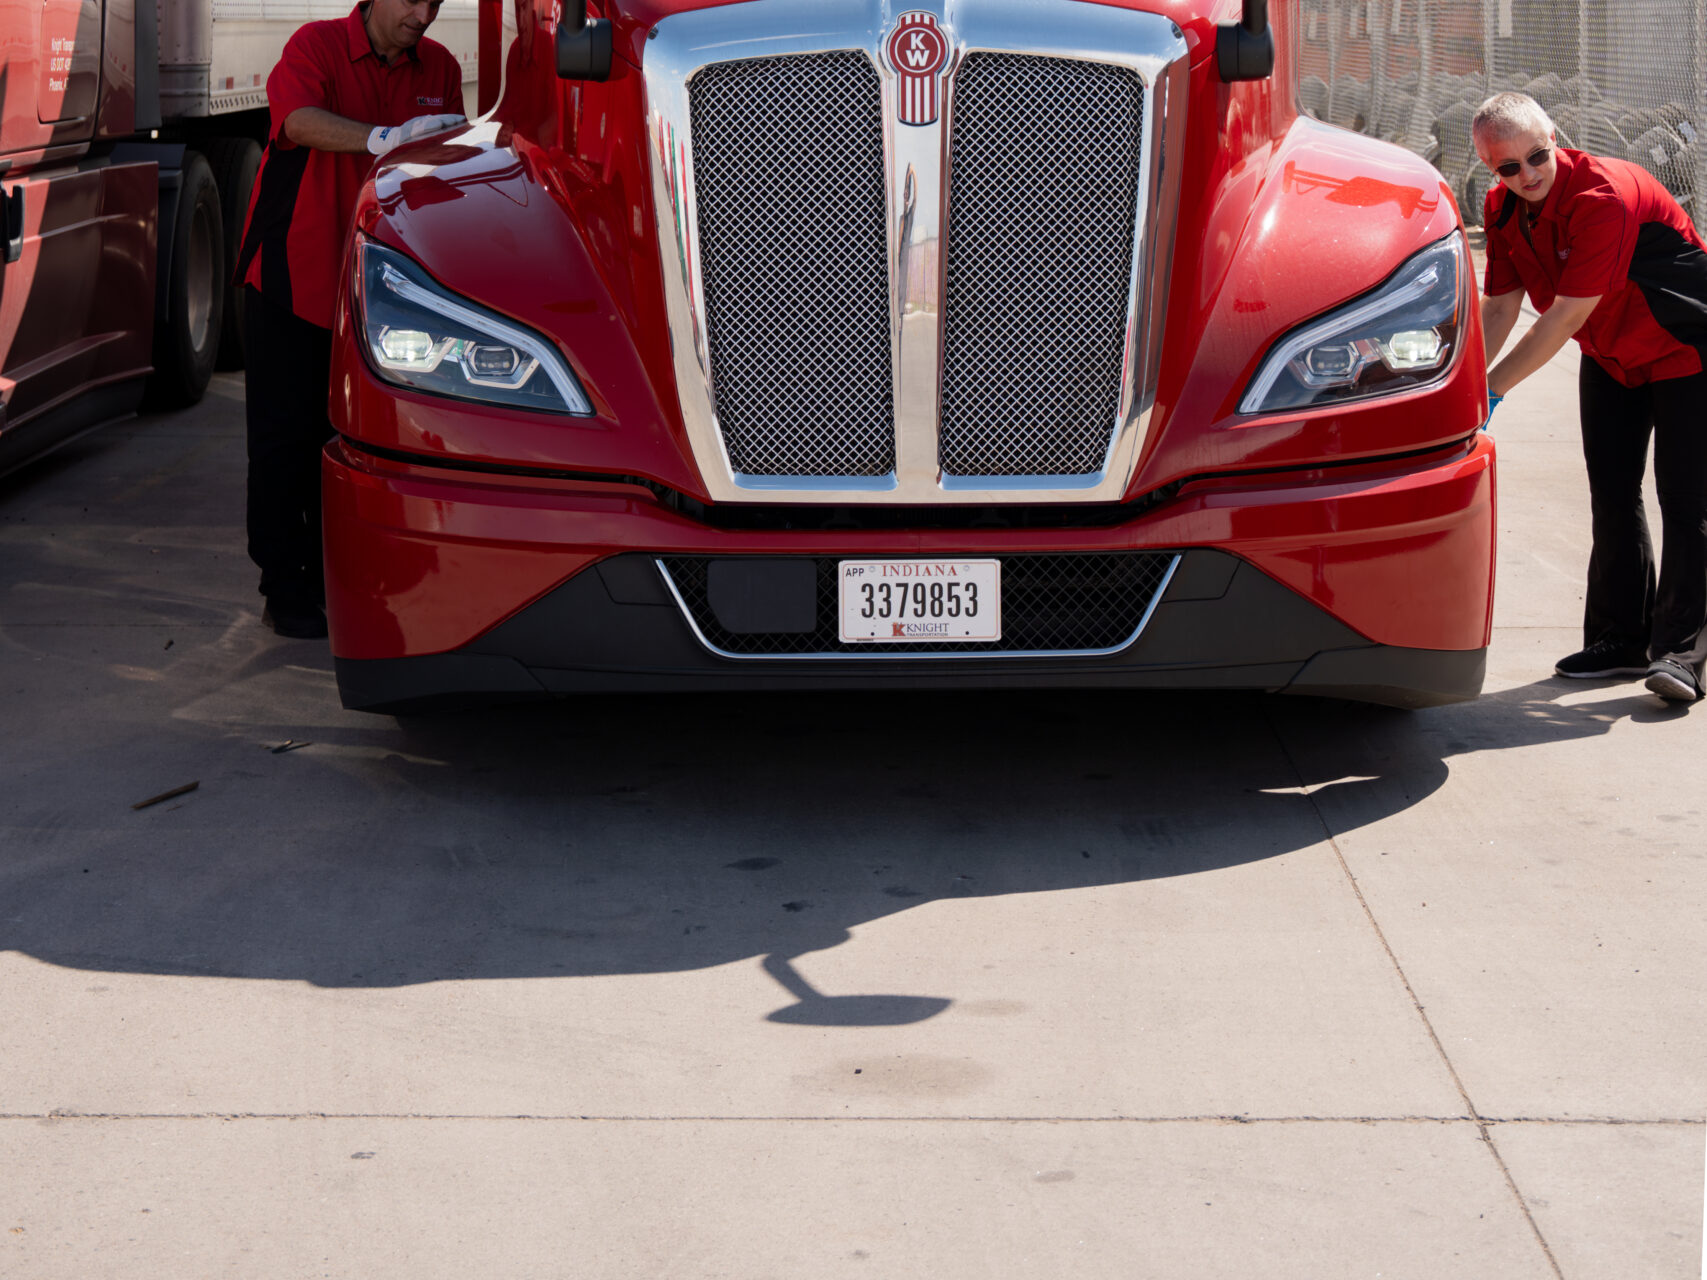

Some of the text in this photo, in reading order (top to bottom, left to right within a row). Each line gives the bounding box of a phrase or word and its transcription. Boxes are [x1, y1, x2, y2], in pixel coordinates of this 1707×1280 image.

[846, 564, 958, 577] APP INDIANA
[861, 581, 979, 618] 3379853
[906, 623, 950, 633] KNIGHT
